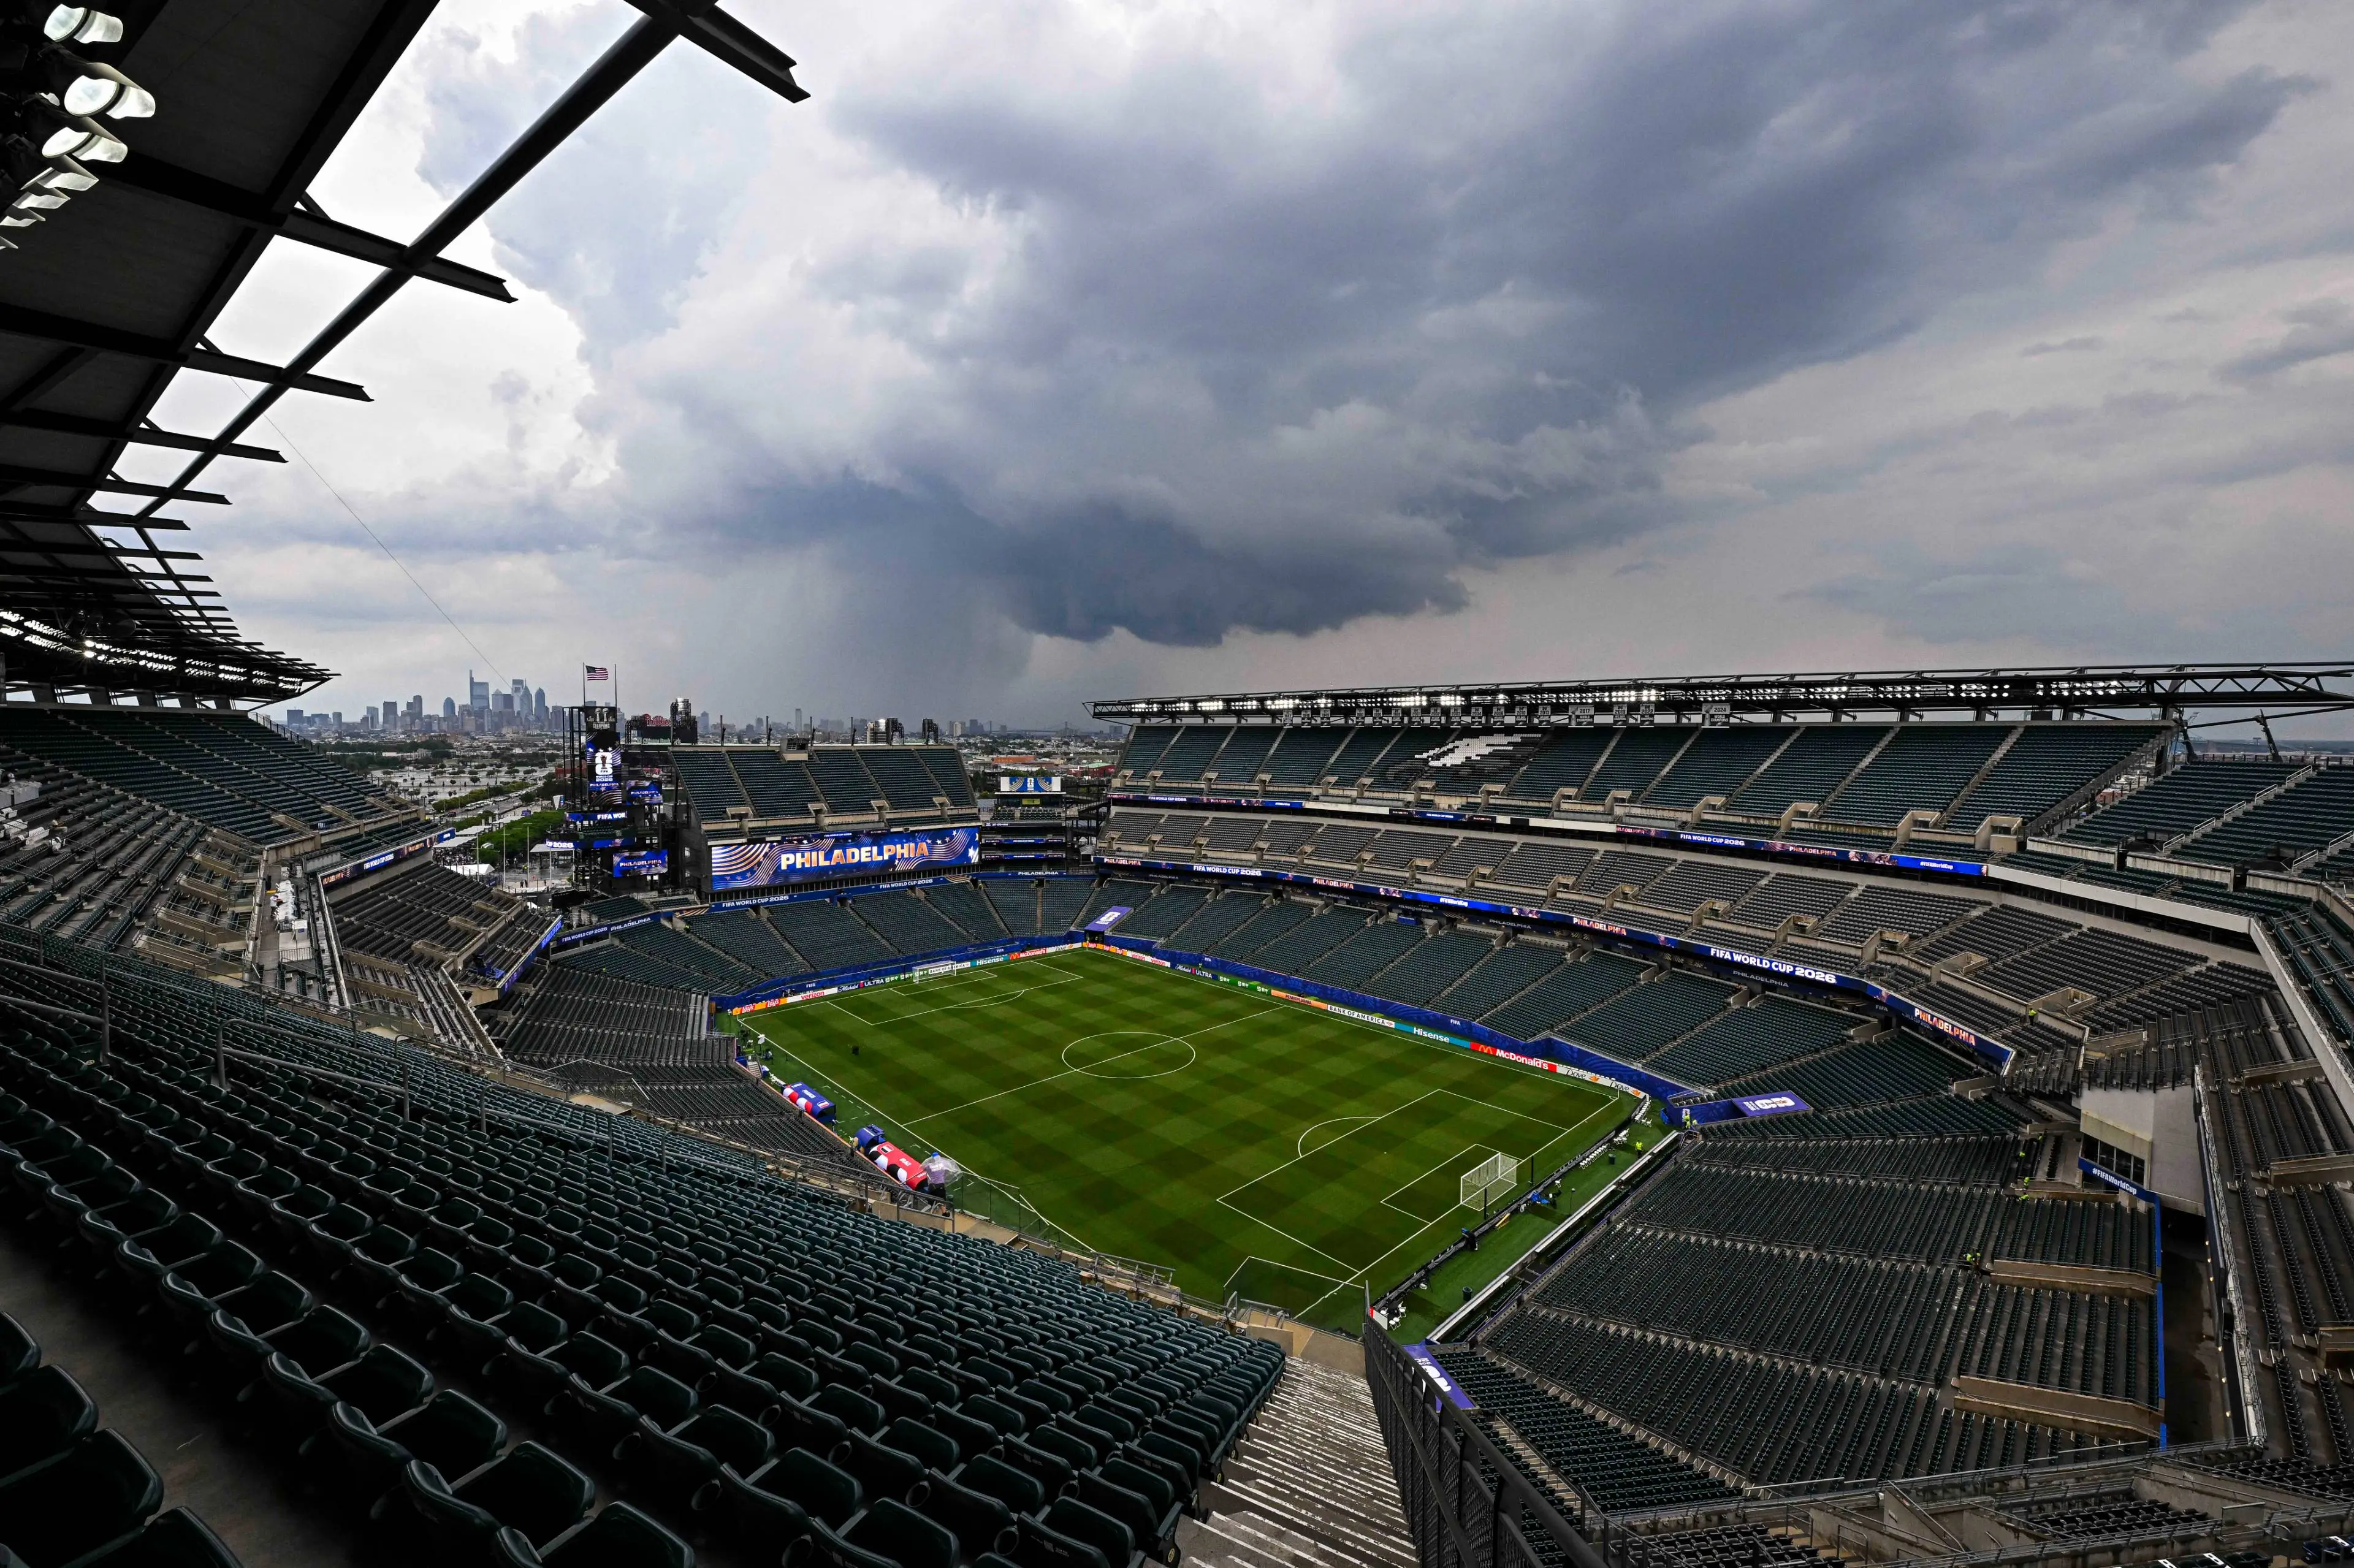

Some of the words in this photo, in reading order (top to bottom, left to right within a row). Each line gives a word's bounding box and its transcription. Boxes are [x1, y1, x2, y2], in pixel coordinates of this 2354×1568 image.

[781, 842, 929, 870] PHILADELPHIA
[1789, 846, 1837, 856] PHILADELPHIA
[1920, 861, 1954, 870] #FIFAWorldCup
[1313, 878, 1354, 889] PHILADELPHIA
[611, 917, 651, 931] PHILADELPHIA
[1489, 919, 1532, 930] PHILADELPHIA
[1573, 918, 1626, 935] PHILADELPHIA
[571, 932, 585, 940] WORLD
[1019, 950, 1046, 958] McDonald's
[977, 956, 1004, 966] Hisense
[1710, 948, 1732, 960] FIFA
[1732, 951, 1770, 969] WORLD
[1772, 961, 1794, 974] CUP
[1795, 967, 1836, 984] 2026
[1195, 970, 1213, 979] ULTRA
[1733, 970, 1789, 988] PHILADELPHIA
[801, 991, 825, 1000] verizon
[1285, 994, 1312, 1005] PENNSYLVANIA
[1329, 1005, 1346, 1014] BANK
[1357, 1013, 1385, 1025] AMERICA
[1914, 1007, 1976, 1046] PHILADELPHIA
[1413, 1027, 1450, 1043] Hisense
[1496, 1049, 1548, 1070] McDonald's
[1566, 1068, 1586, 1079] Dove
[1609, 1081, 1629, 1092] Dove
[2092, 1167, 2137, 1195] #FIFAWorldCup
